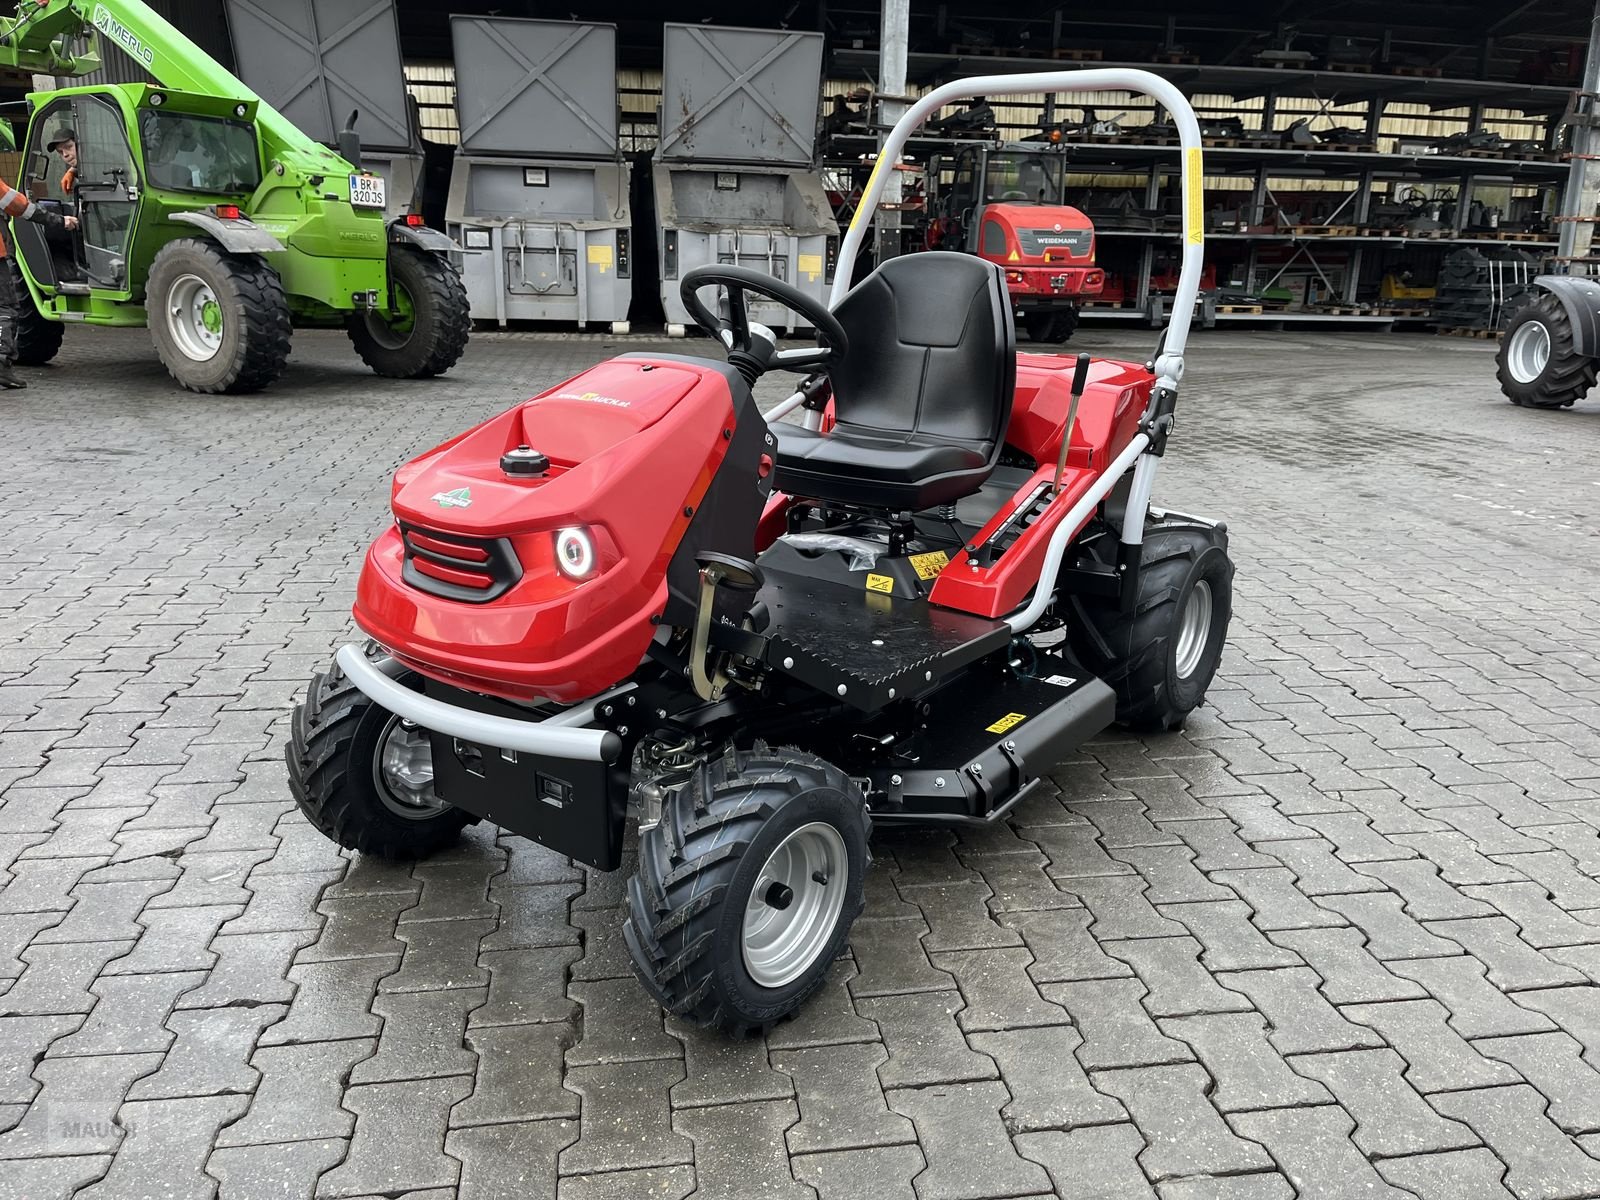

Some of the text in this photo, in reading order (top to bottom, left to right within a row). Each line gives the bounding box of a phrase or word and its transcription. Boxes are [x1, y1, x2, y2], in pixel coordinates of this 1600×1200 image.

[110, 20, 153, 64] MERLO
[360, 178, 372, 191] BR
[338, 231, 379, 242] MERLO
[1037, 237, 1078, 245] WEIDEMANN
